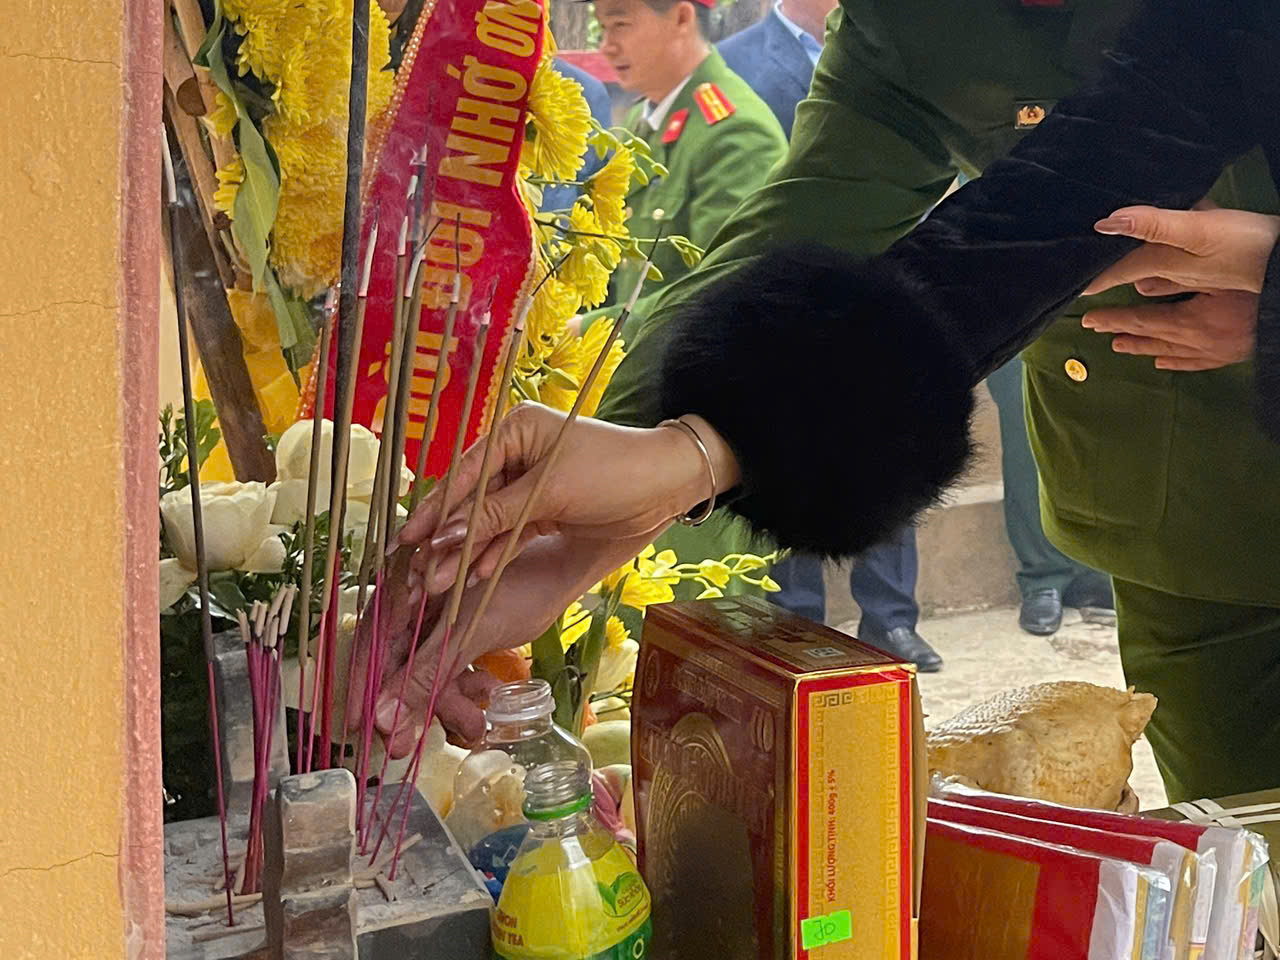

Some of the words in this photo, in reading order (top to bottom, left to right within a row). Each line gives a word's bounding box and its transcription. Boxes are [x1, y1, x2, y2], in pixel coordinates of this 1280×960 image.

[438, 55, 528, 187] NHỚ
[826, 769, 836, 784] 5%
[827, 792, 838, 816] 400g
